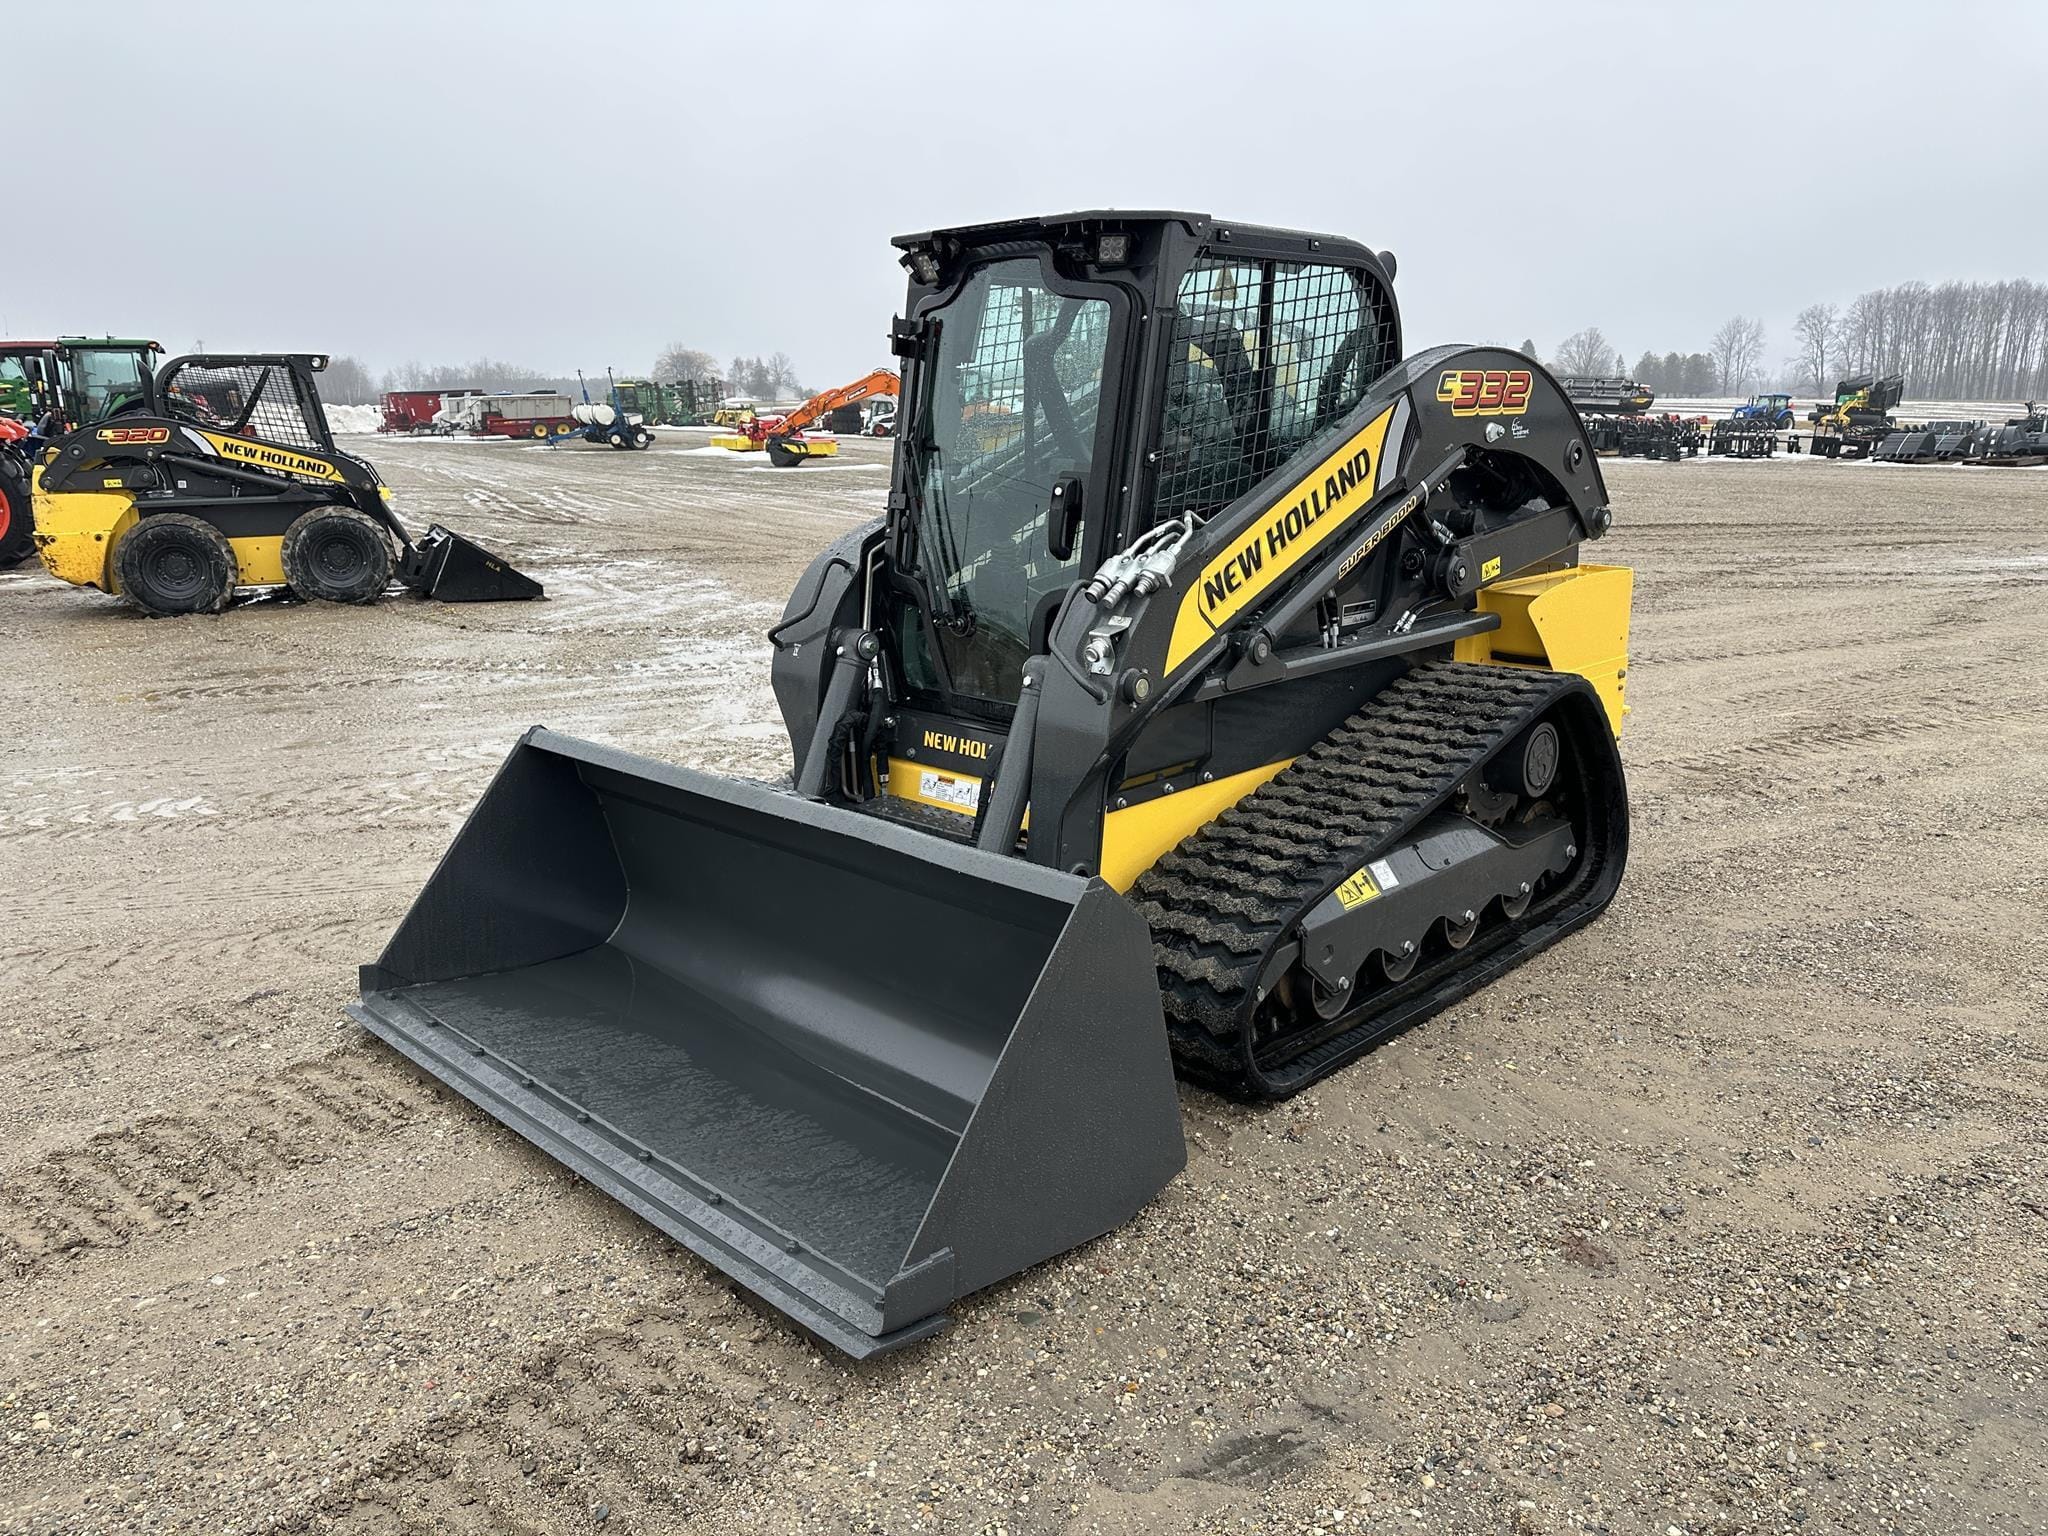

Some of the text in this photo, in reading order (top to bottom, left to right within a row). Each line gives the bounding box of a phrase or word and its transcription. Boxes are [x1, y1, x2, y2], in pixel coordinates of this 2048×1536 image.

[1437, 371, 1532, 415] C332
[97, 428, 169, 444] L320
[223, 442, 327, 475] NEW HOLLAND
[1203, 448, 1371, 611] NEW HOLLAND
[1339, 495, 1417, 580] SUPER BOOM
[924, 730, 993, 760] NEW HOL
